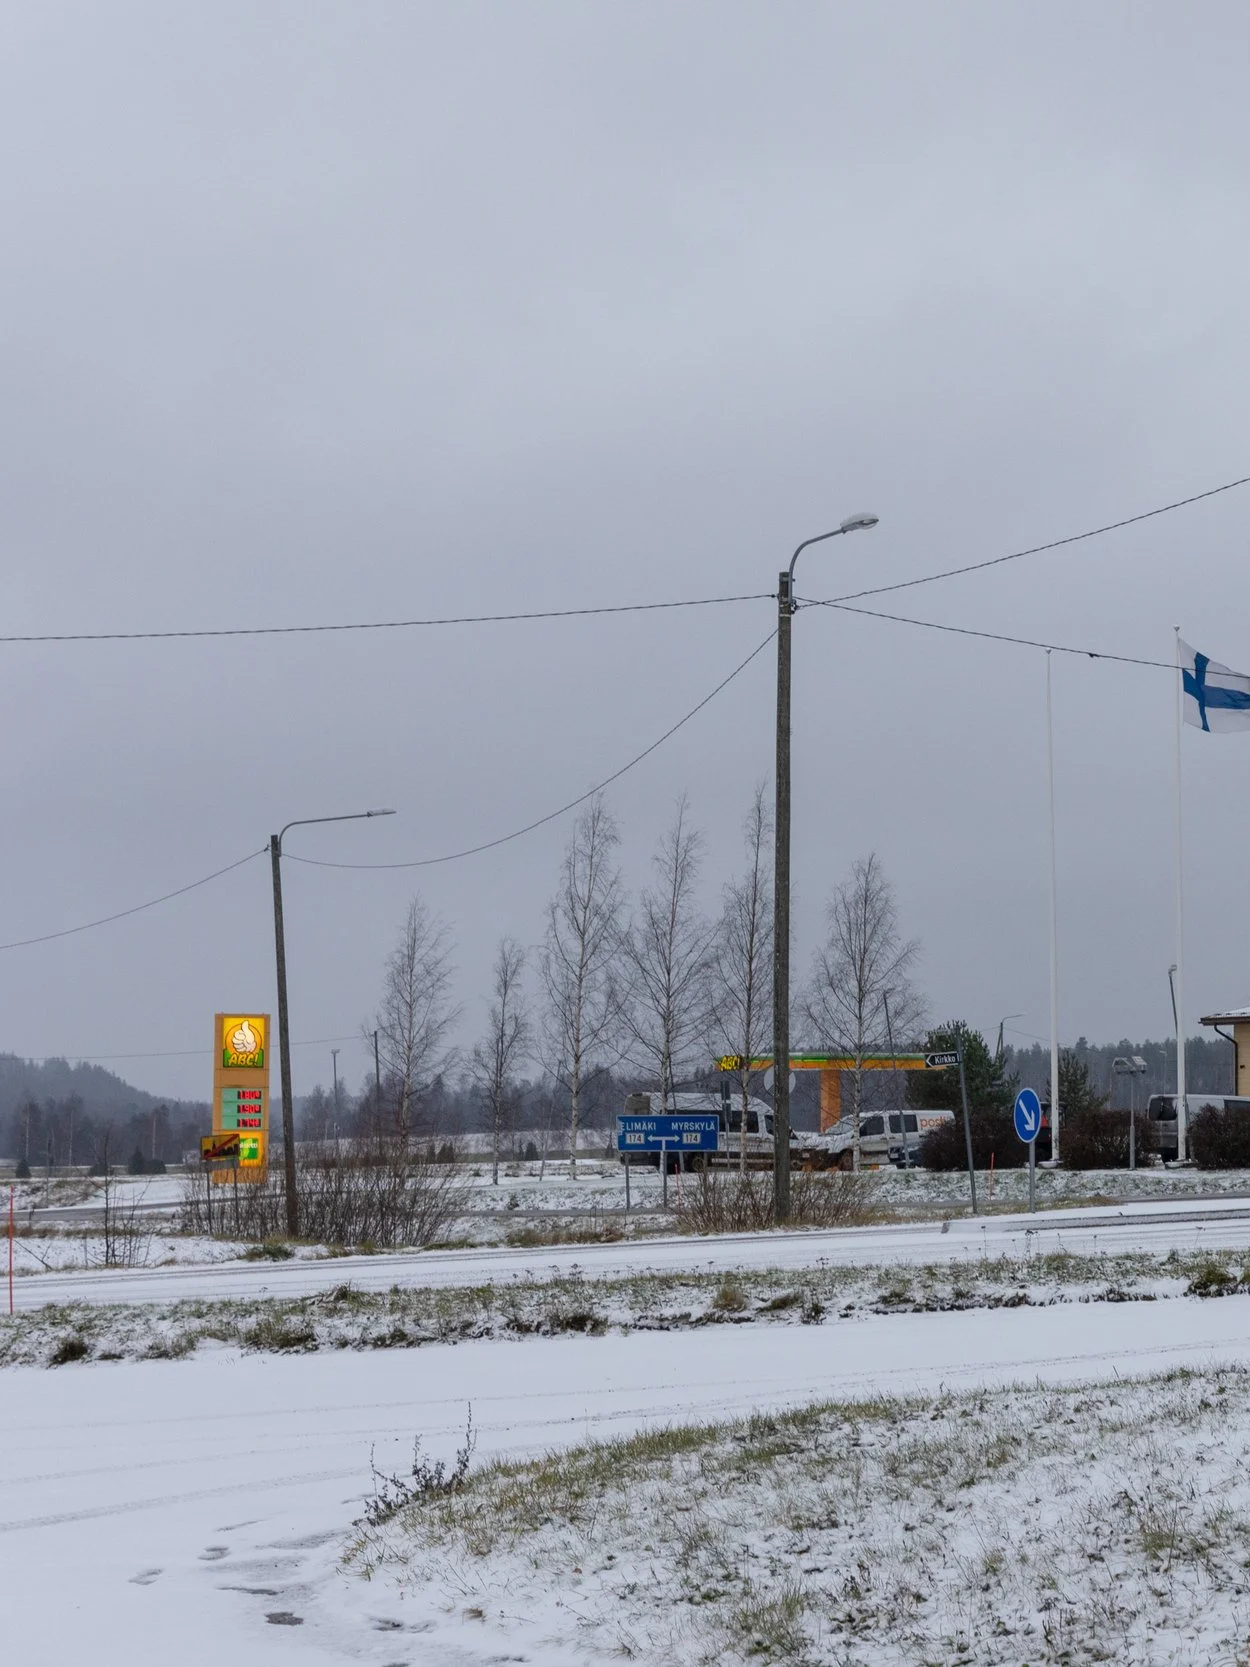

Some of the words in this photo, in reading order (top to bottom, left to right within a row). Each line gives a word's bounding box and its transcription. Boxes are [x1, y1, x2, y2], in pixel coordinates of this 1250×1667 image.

[228, 1052, 259, 1066] ABC!
[934, 1055, 956, 1064] Kirkko
[620, 1121, 656, 1131] ELIMÄKI
[671, 1121, 715, 1131] MYRSKYLÄ
[628, 1134, 642, 1143] 174
[686, 1134, 698, 1143] 174
